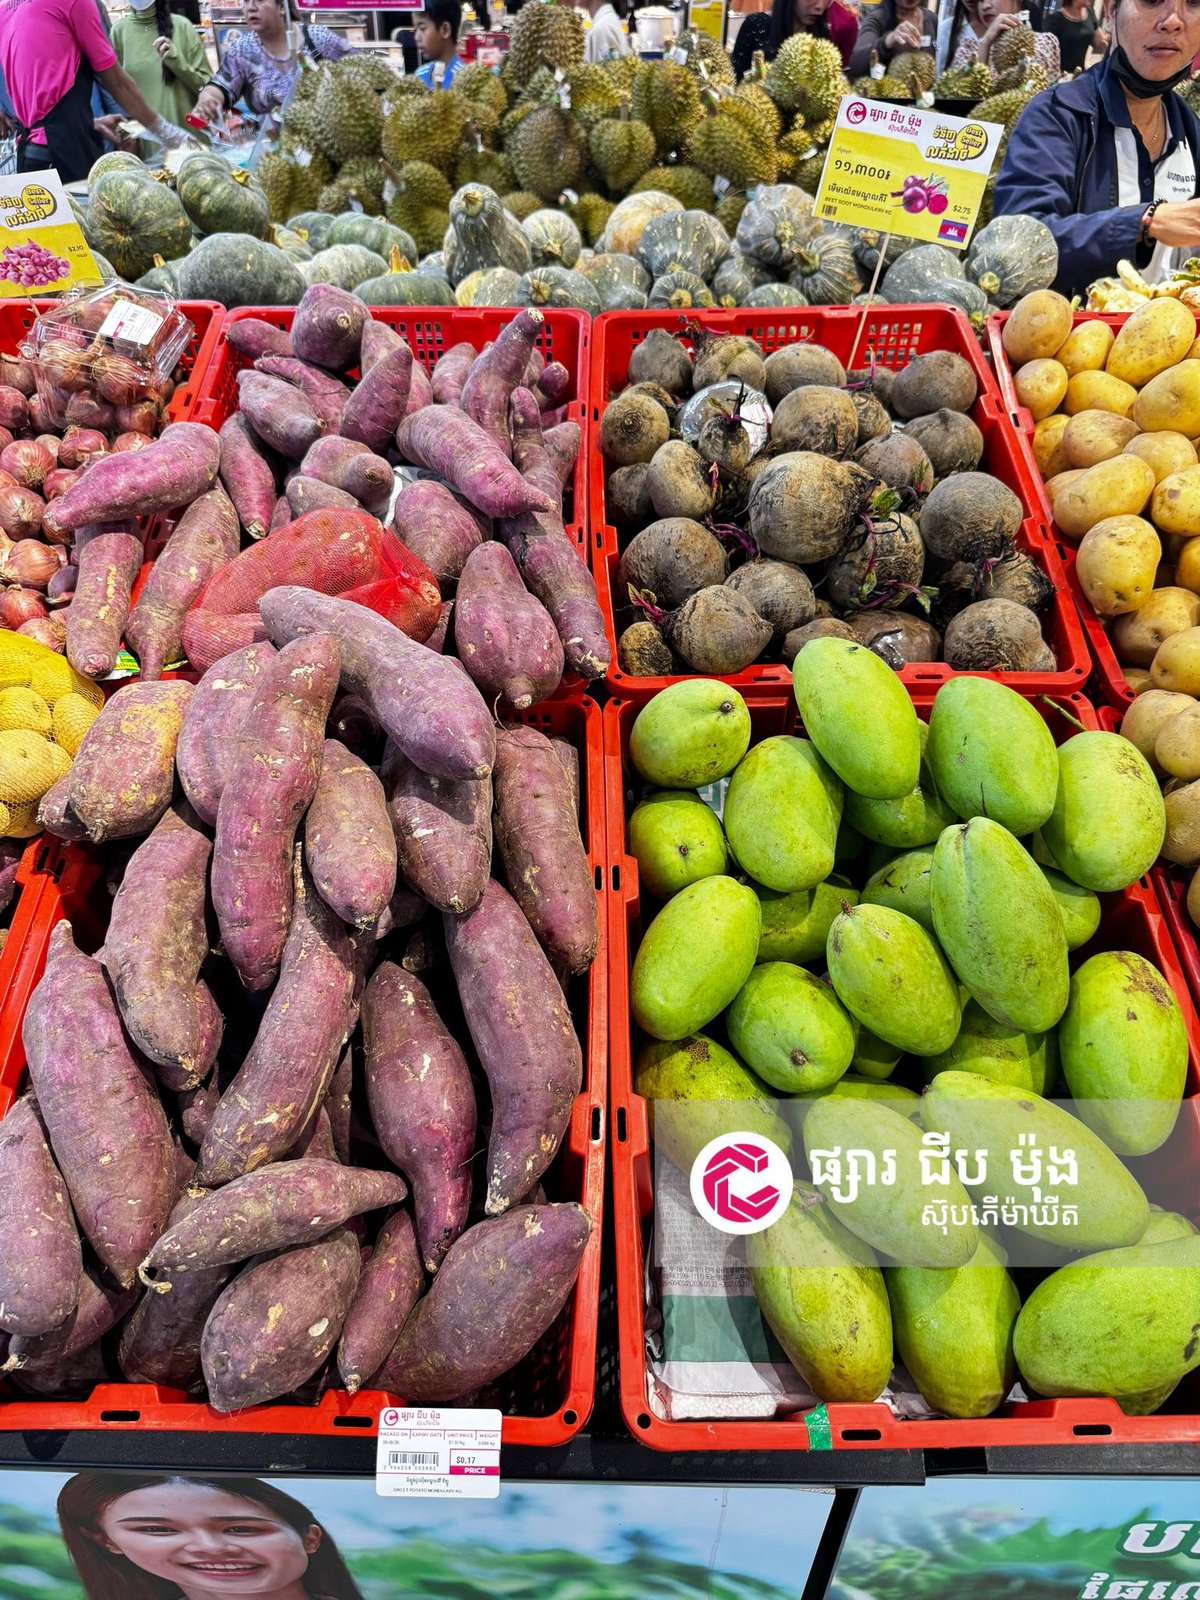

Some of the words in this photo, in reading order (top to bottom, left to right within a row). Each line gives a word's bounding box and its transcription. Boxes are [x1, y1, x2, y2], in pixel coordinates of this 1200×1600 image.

[965, 127, 984, 138] Best
[961, 136, 983, 148] Seller
[25, 187, 45, 196] Best
[28, 197, 51, 206] Seller
[952, 204, 971, 215] $2.75
[456, 1456, 476, 1465] $0.17
[464, 1467, 486, 1475] PRICE
